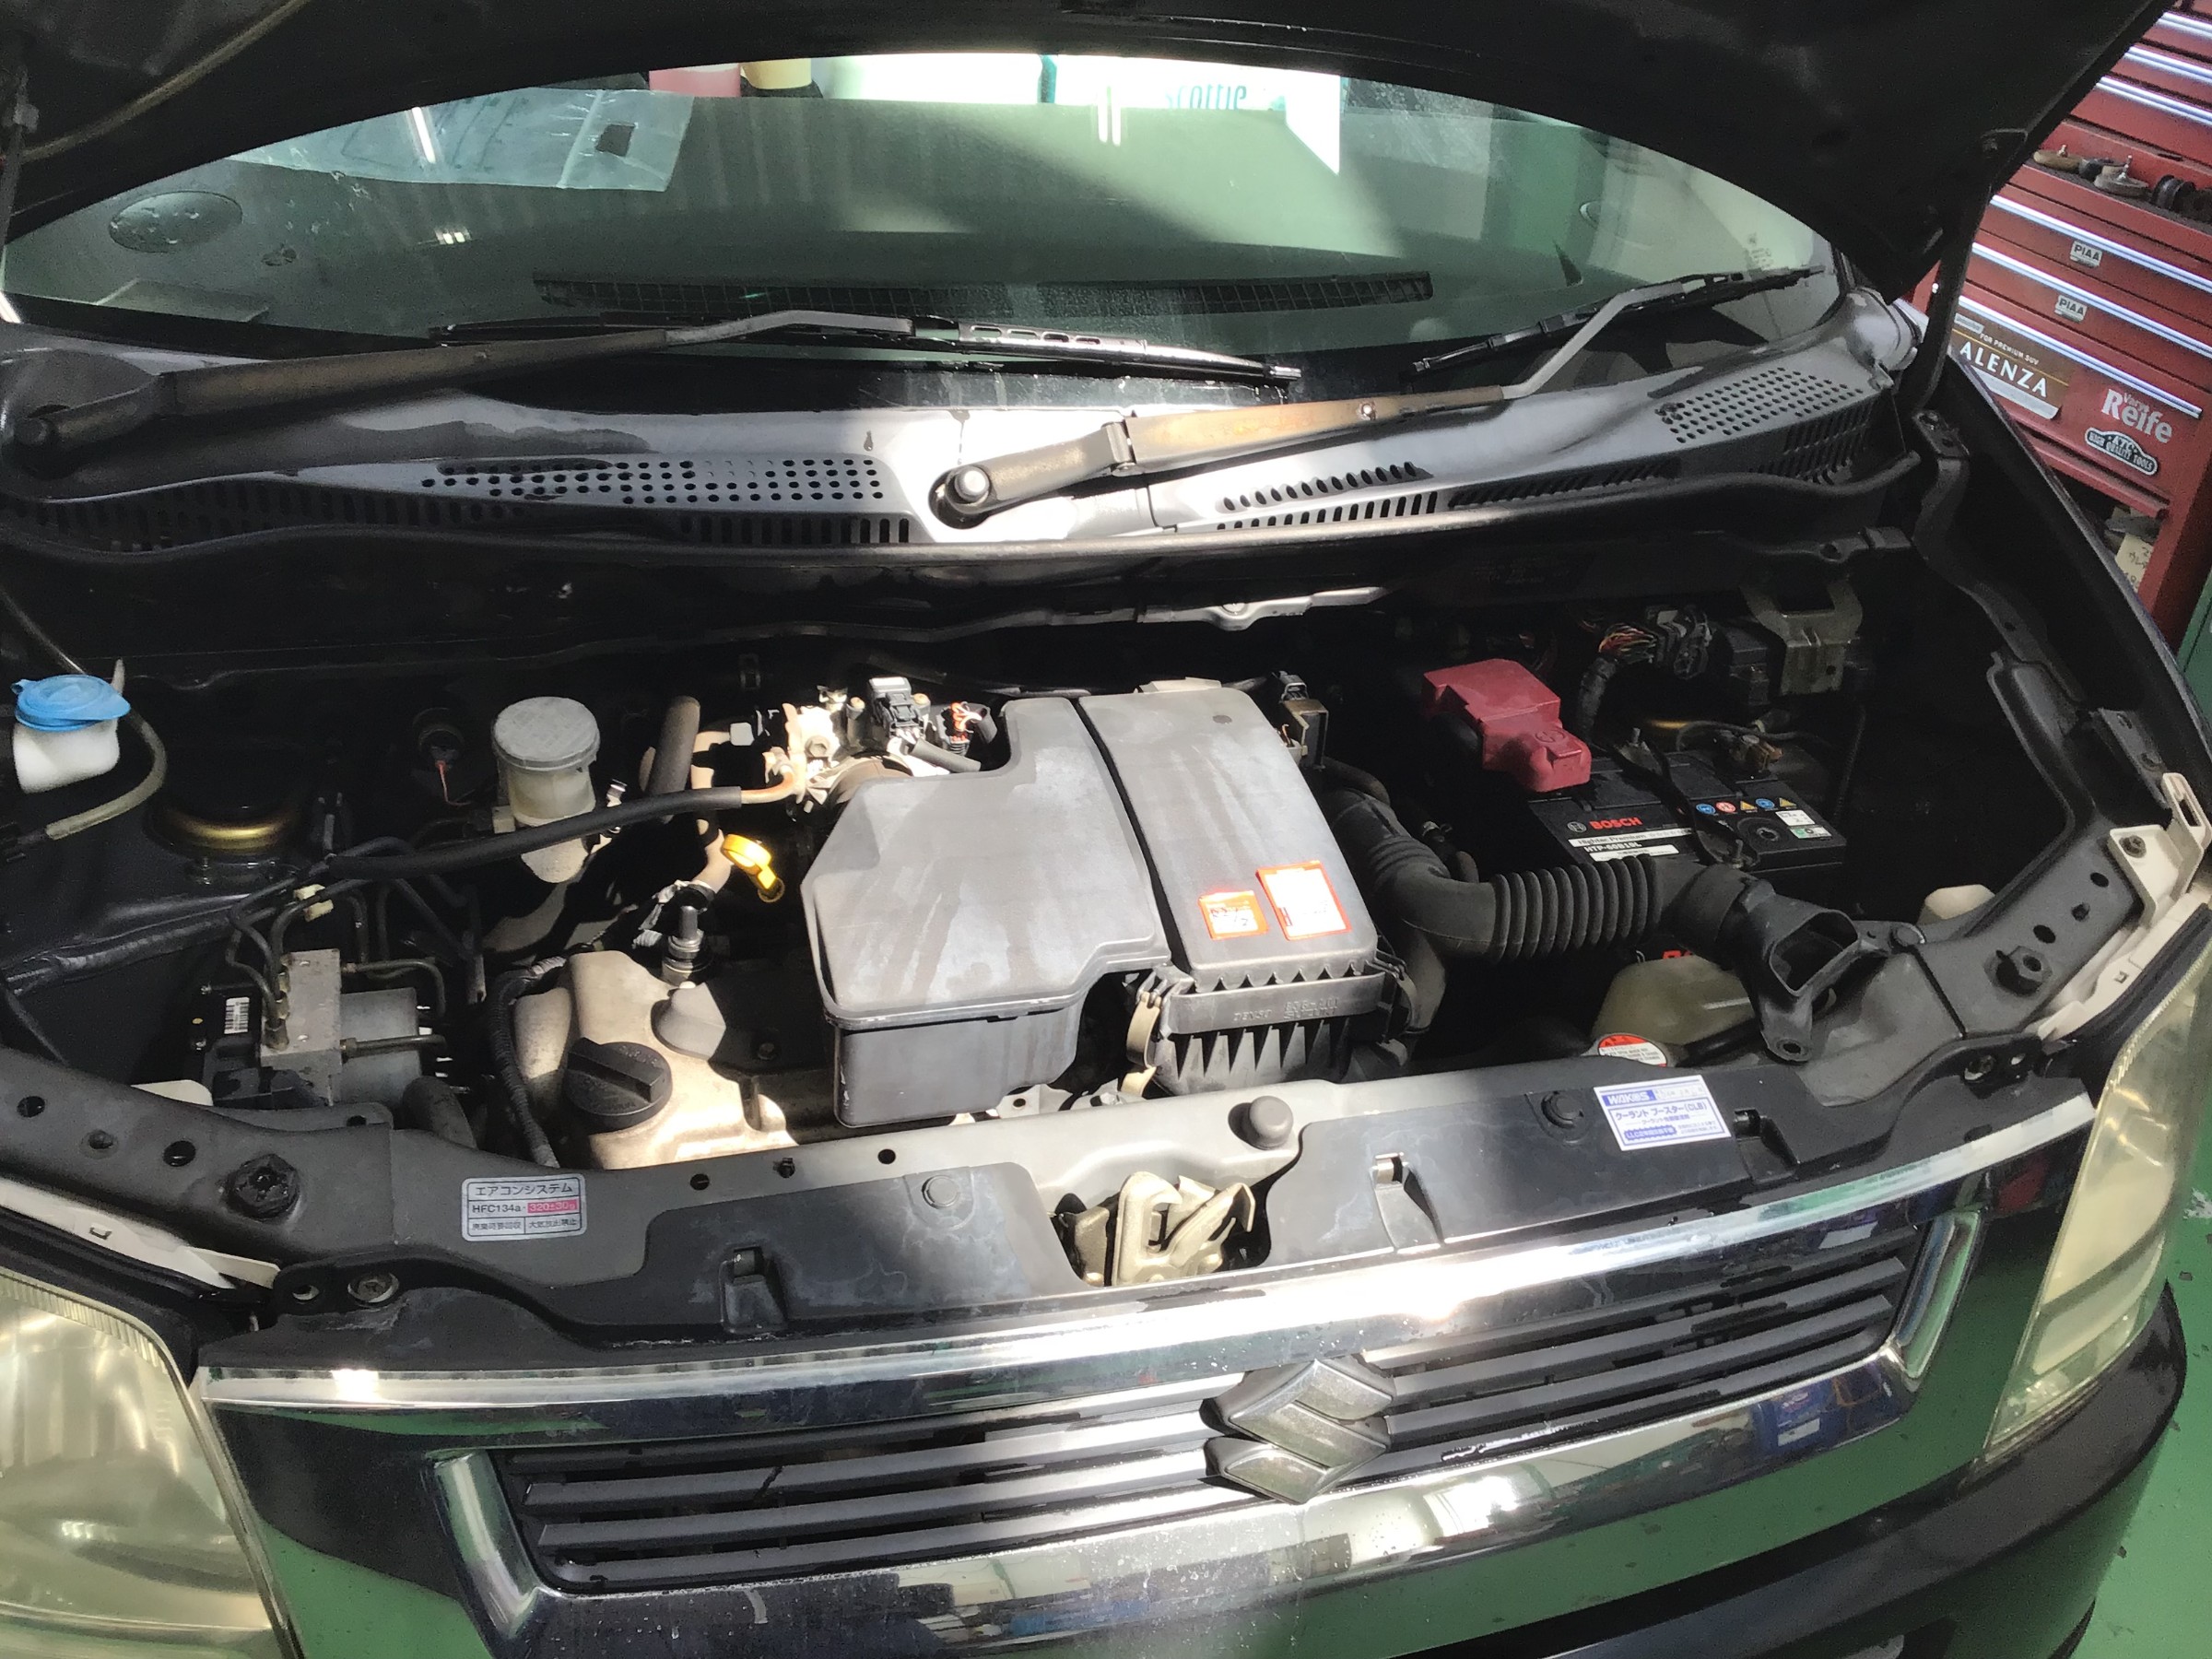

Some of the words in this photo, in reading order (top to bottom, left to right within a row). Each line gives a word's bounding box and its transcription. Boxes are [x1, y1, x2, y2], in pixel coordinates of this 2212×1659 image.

[2074, 243, 2100, 261] PIAA
[2058, 298, 2084, 315] PIAA
[1980, 333, 1993, 347] FOR
[1994, 339, 2024, 359] PREMIUM
[2025, 354, 2040, 366] SUV
[1959, 341, 2047, 398] ALENZA
[2101, 388, 2172, 443] Reife
[2134, 454, 2152, 471] TOOLS
[1589, 817, 1643, 830] BOSCH
[1609, 833, 1647, 842] Premium
[1616, 1109, 1649, 1121] クーラント
[476, 1182, 573, 1196] エアコンシステム
